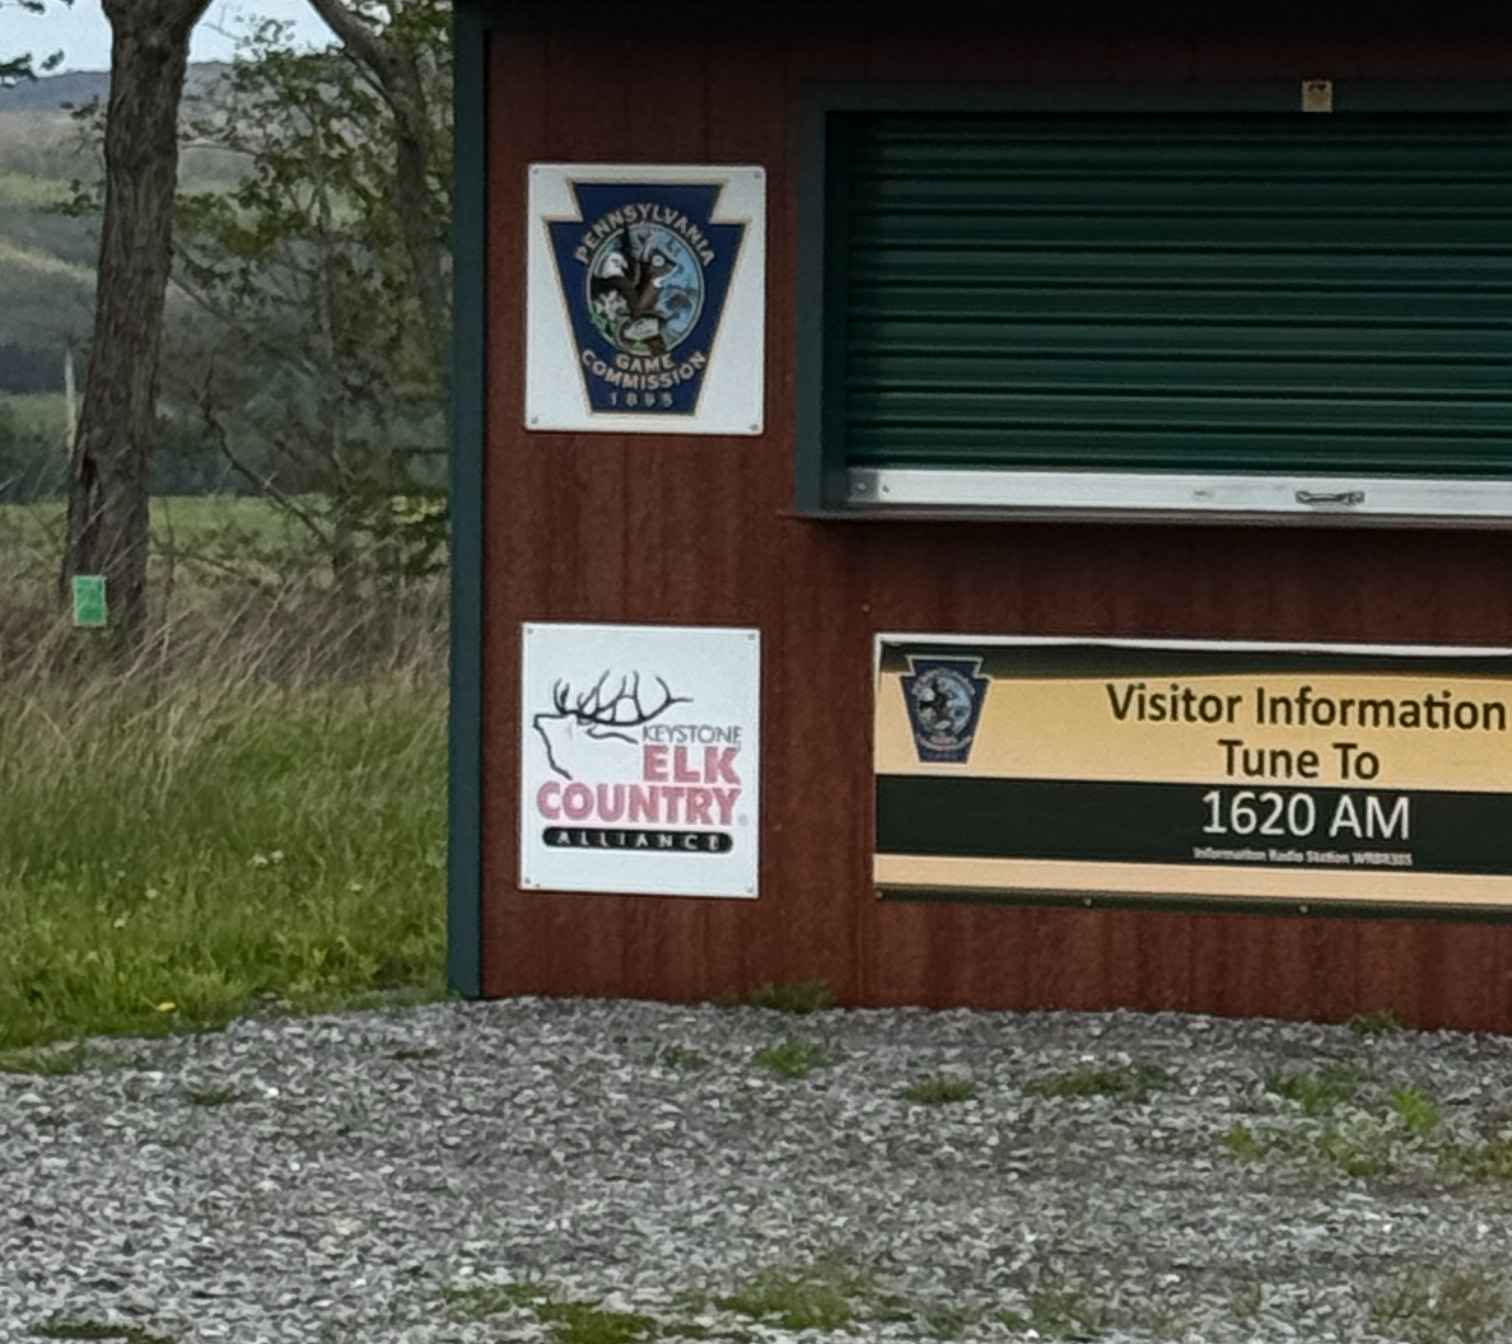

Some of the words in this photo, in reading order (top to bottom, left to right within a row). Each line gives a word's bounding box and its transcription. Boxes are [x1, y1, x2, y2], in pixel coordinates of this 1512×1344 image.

[575, 203, 715, 266] PENNSYLVANIA
[582, 349, 707, 389] COMMISSION
[616, 353, 675, 373] GAME
[1105, 683, 1242, 723] Visitor
[1256, 686, 1507, 731] Information
[643, 724, 742, 745] KEYSTONE
[643, 744, 742, 785] ELK
[1218, 739, 1320, 779] Tune
[1332, 743, 1380, 780] To
[536, 780, 742, 826] COUNTRY
[1202, 790, 1316, 837] 1620
[1329, 796, 1411, 841] AM
[555, 828, 720, 851] ALLIANCE
